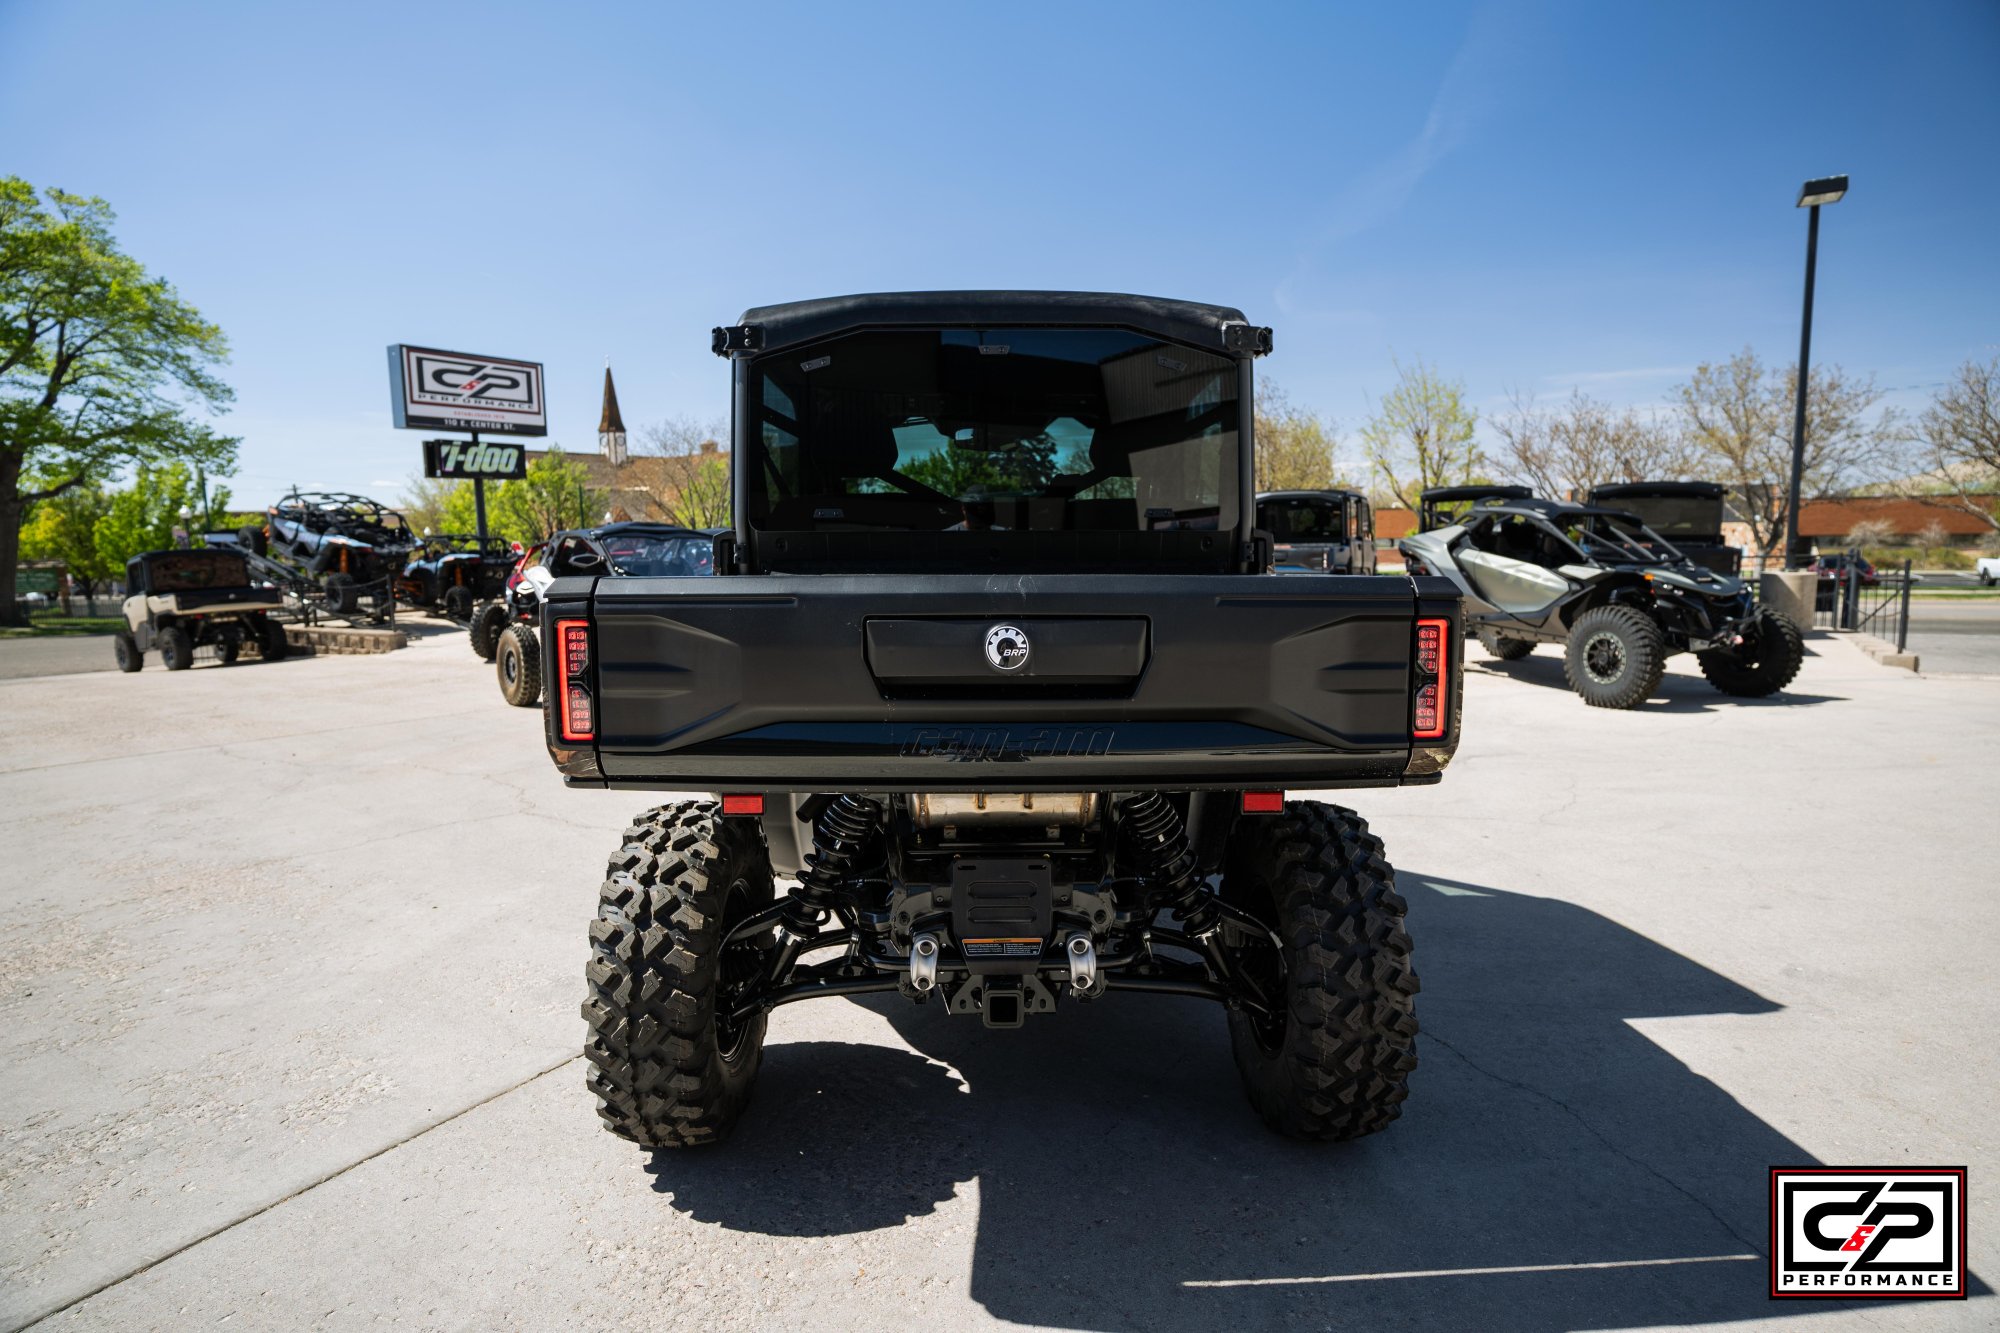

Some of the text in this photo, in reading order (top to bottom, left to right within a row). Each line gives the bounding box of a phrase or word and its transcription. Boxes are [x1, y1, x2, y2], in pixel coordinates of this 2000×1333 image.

[418, 394, 534, 409] PERFORMANCE
[444, 418, 457, 427] 110
[470, 420, 501, 430] CENTER
